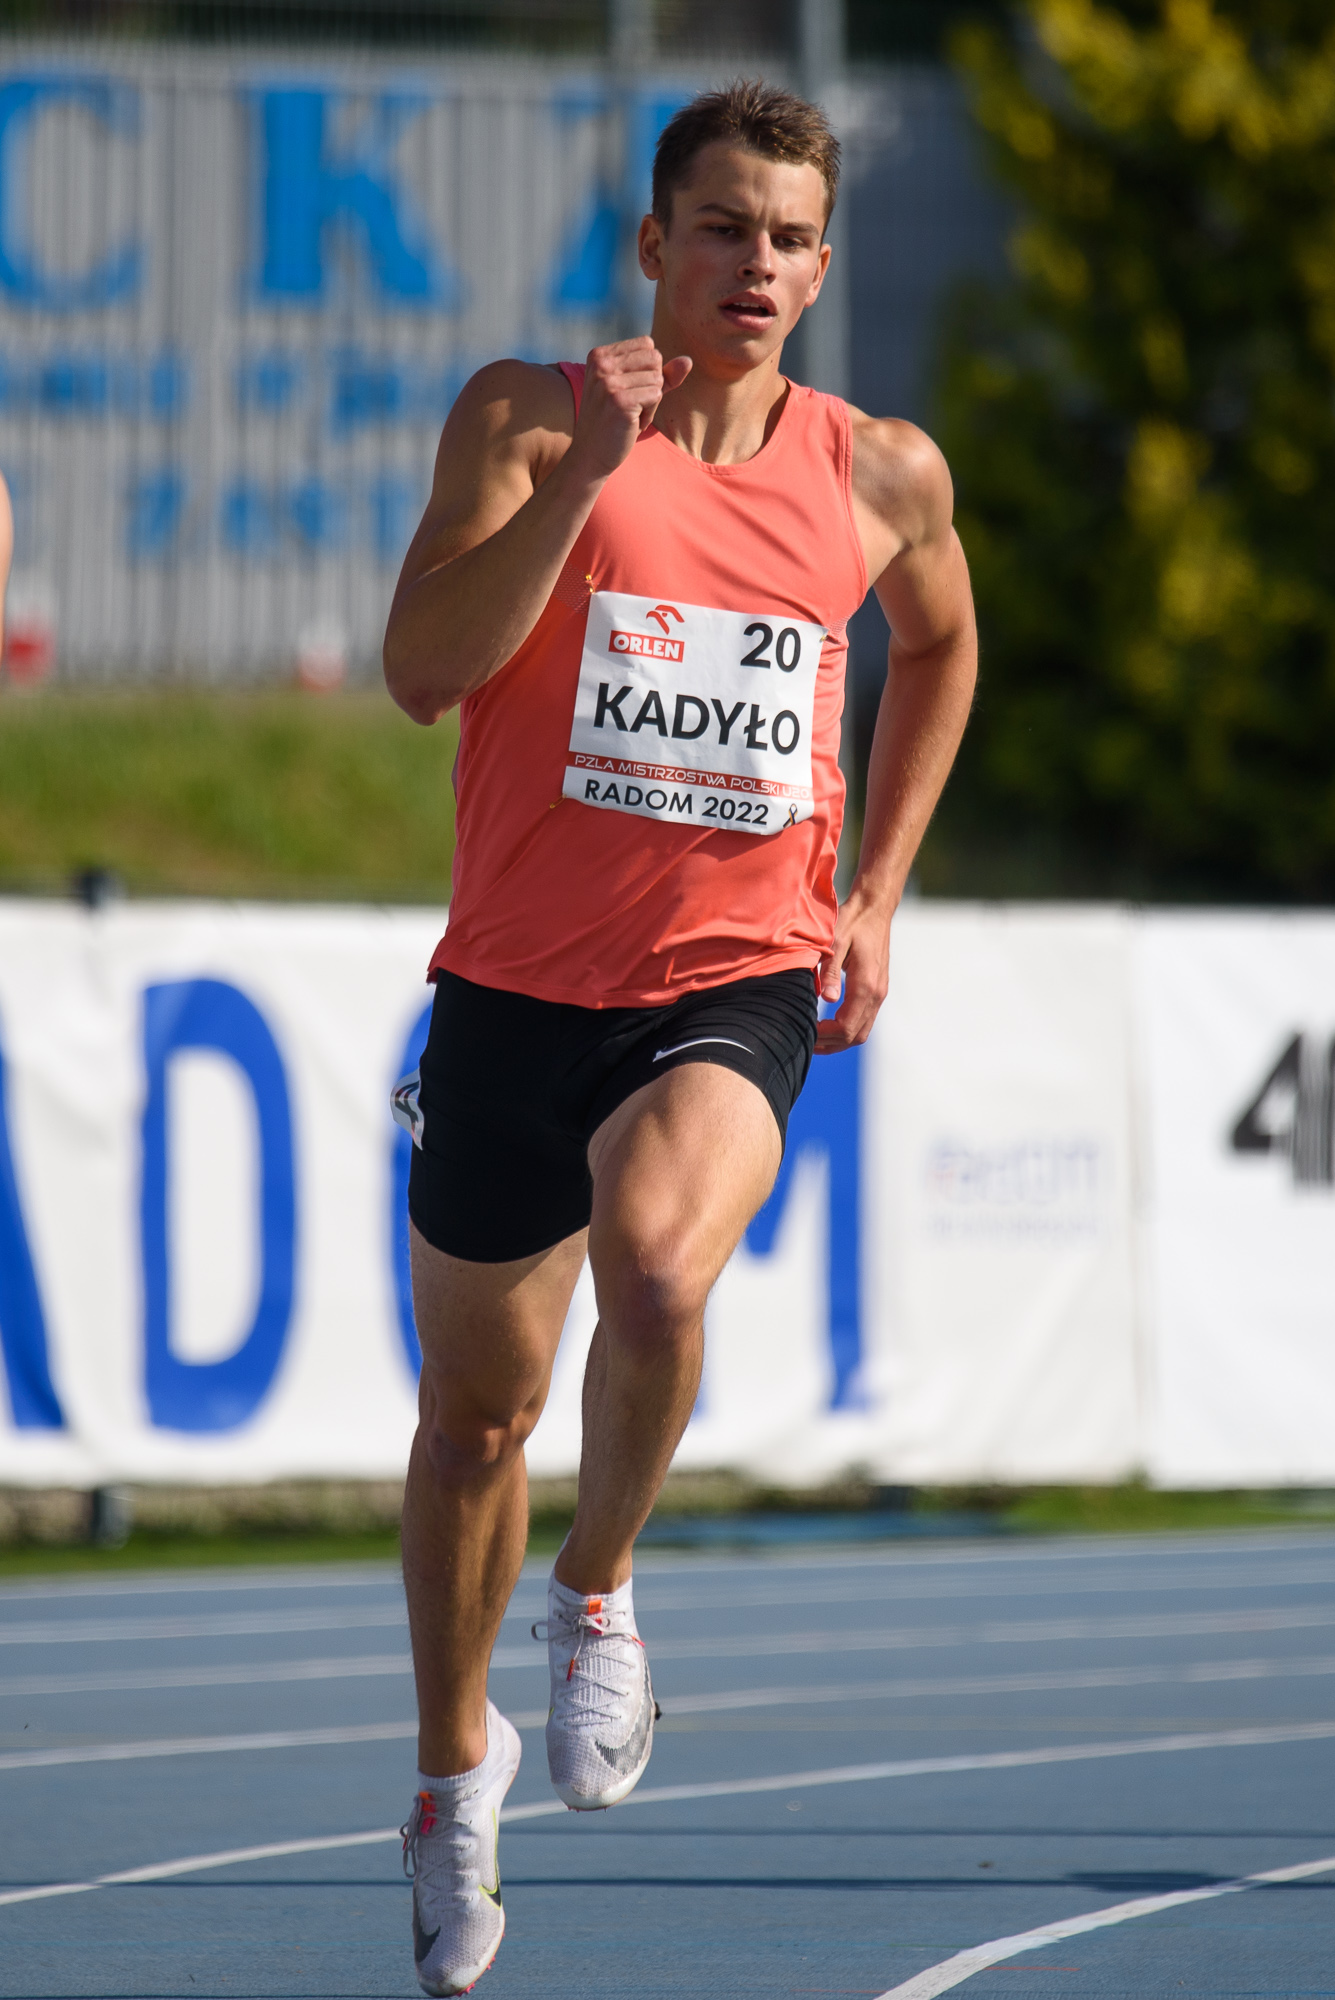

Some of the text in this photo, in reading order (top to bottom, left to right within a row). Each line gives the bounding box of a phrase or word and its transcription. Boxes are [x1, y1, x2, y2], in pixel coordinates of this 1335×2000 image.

[613, 634, 681, 660] ORLEN
[740, 622, 801, 673] 20
[593, 682, 800, 756] KADYŁO
[575, 754, 810, 799] PZLA MISTRZOSTWA POLSKI U20
[584, 778, 769, 826] RADOM 2022
